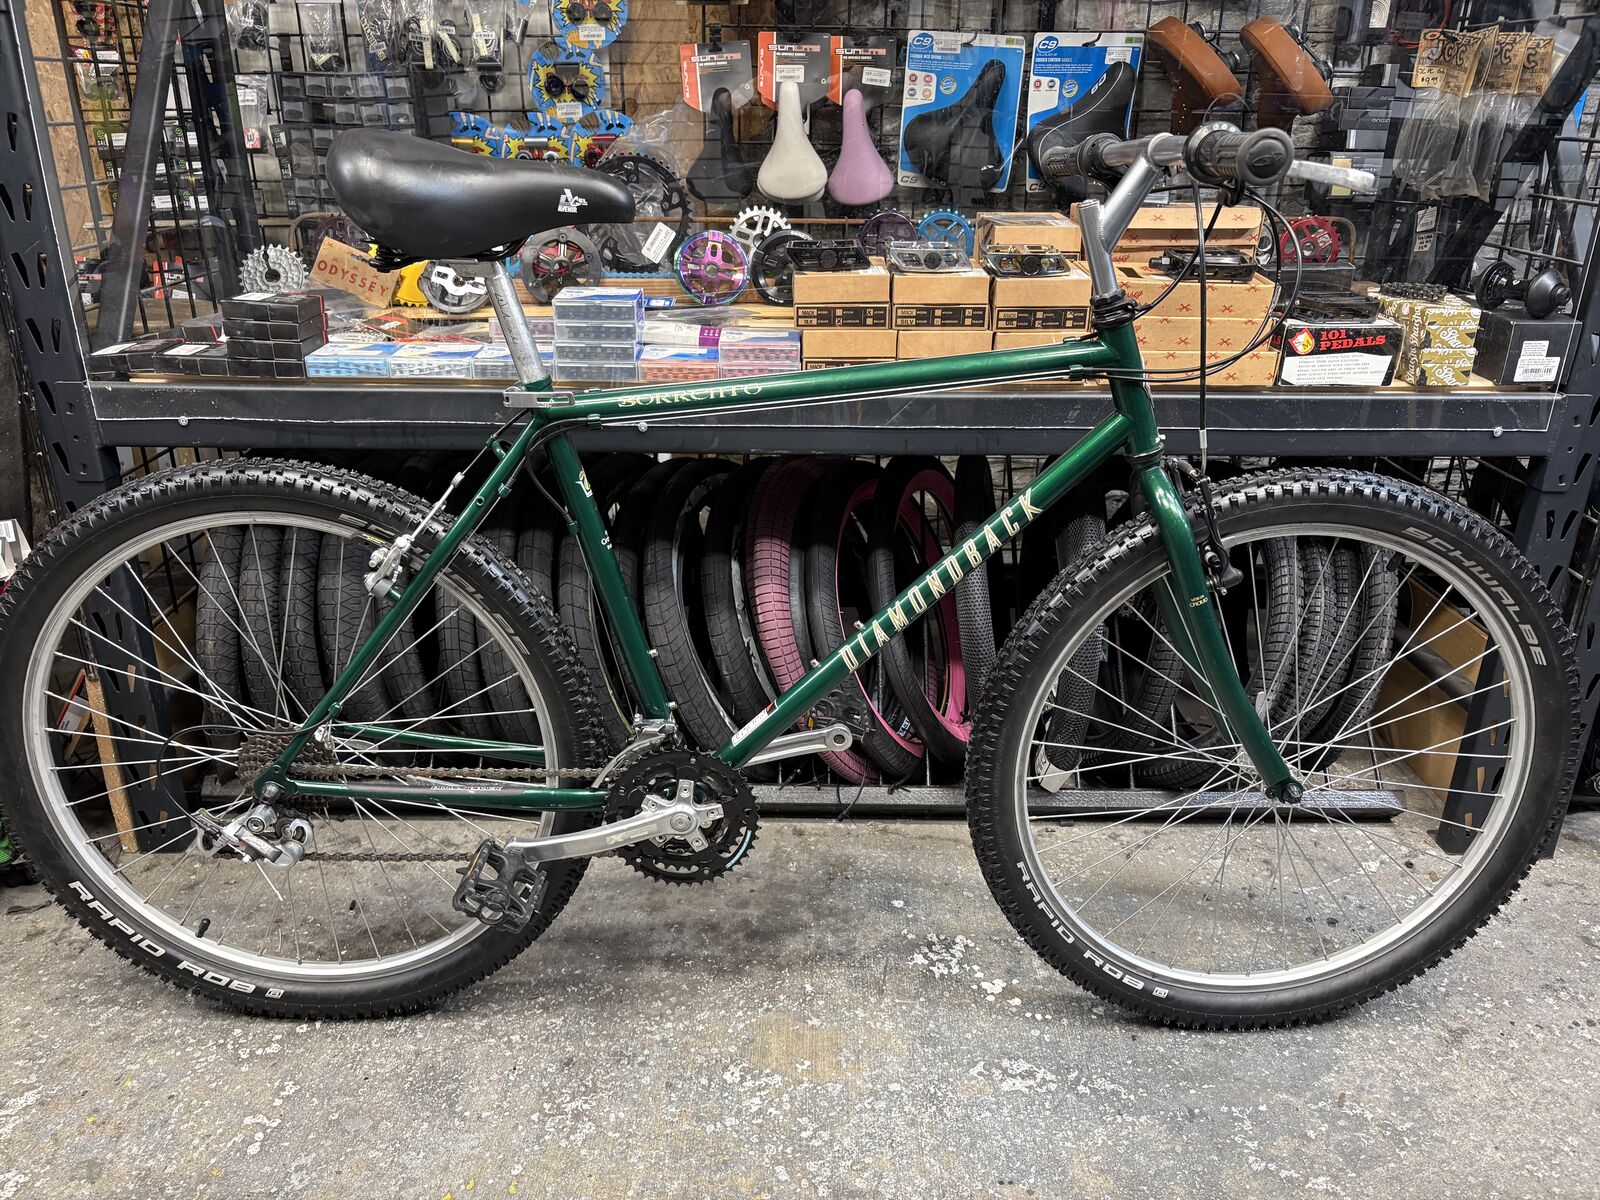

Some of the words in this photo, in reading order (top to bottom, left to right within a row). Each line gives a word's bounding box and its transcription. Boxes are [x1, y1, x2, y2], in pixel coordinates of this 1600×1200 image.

[913, 37, 932, 45] C9
[1039, 40, 1057, 49] C9
[317, 260, 389, 297] ODYSSEY
[1320, 329, 1347, 340] 101
[1320, 335, 1386, 351] PEDALS
[839, 487, 1044, 673] DIAMONDBACK
[1401, 526, 1547, 666] SCHWALBE
[68, 880, 166, 957] RAPID
[176, 960, 257, 994] ROB
[1016, 861, 1075, 944] RAPID
[1083, 950, 1145, 990] ROB
